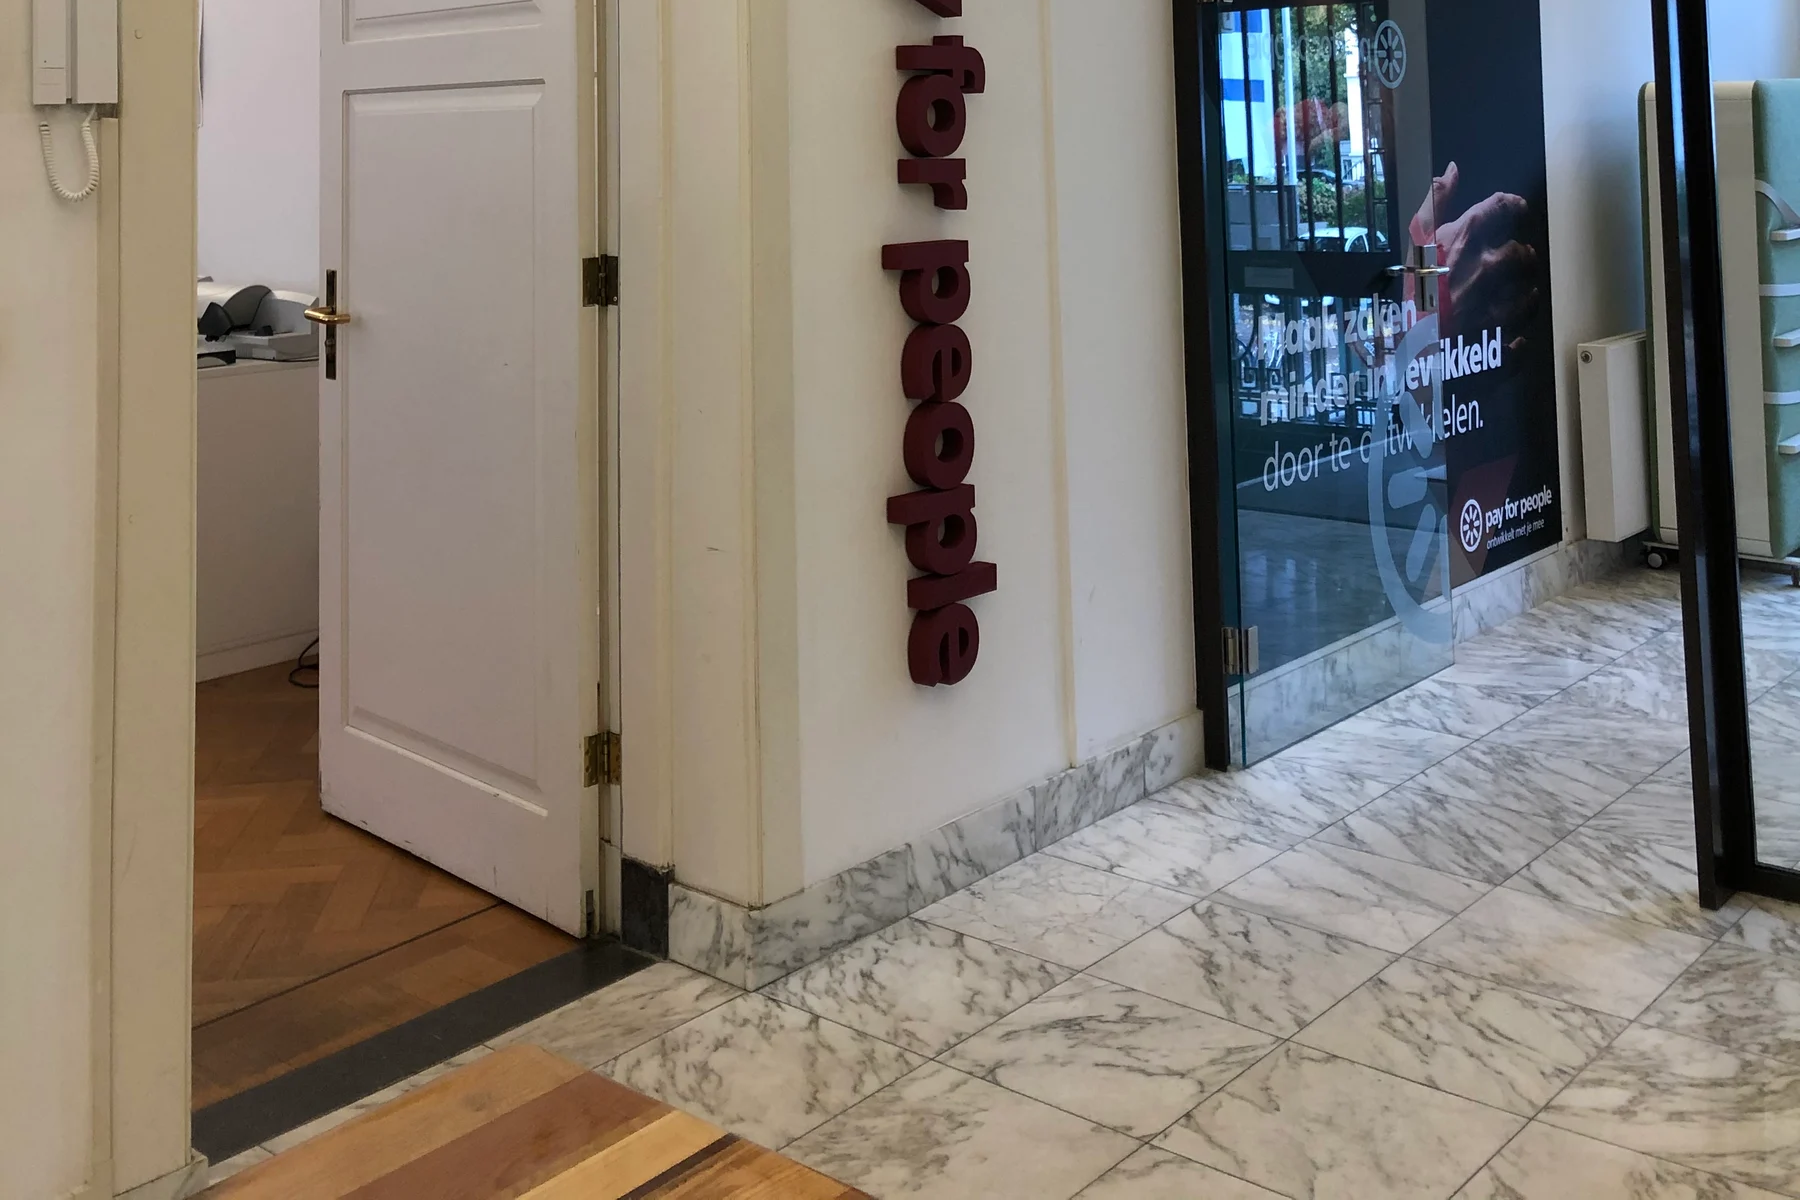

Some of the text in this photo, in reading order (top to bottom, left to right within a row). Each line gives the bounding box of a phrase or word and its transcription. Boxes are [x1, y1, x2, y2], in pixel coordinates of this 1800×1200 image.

[896, 35, 985, 211] for
[1344, 293, 1417, 344] zaken
[1260, 326, 1502, 427] minder inewikkeld
[881, 239, 997, 687] people
[1263, 440, 1324, 492] door
[1329, 432, 1352, 473] te
[1485, 484, 1553, 534] pay for people
[1515, 523, 1526, 539] met
[1526, 521, 1532, 536] je
[1533, 518, 1545, 531] mee
